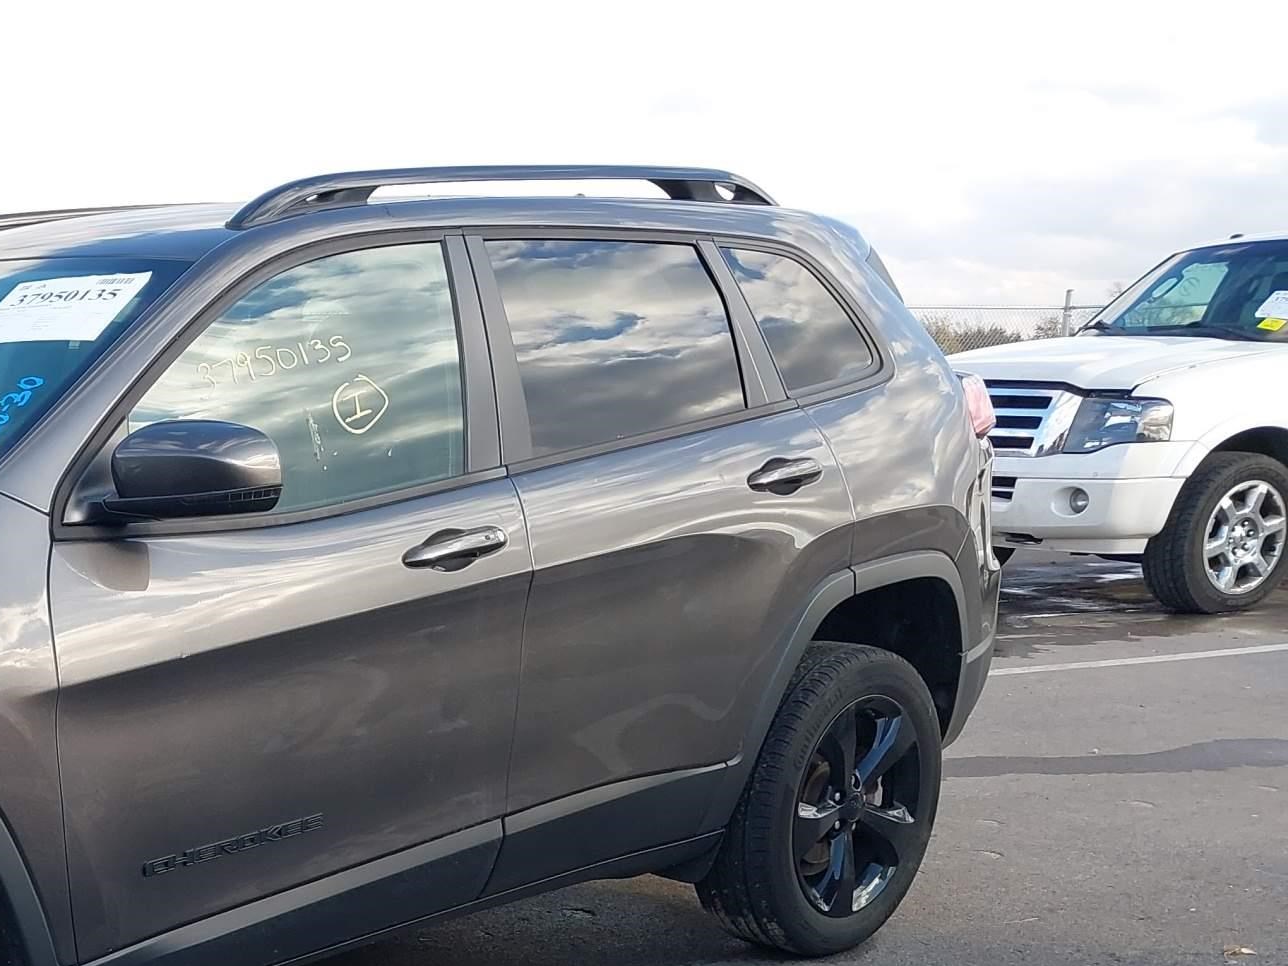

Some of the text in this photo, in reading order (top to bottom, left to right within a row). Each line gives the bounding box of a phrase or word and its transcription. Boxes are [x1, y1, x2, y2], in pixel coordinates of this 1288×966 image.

[11, 288, 123, 307] 37950135
[197, 335, 352, 399] 37950135
[142, 812, 324, 878] CHEROKEE
